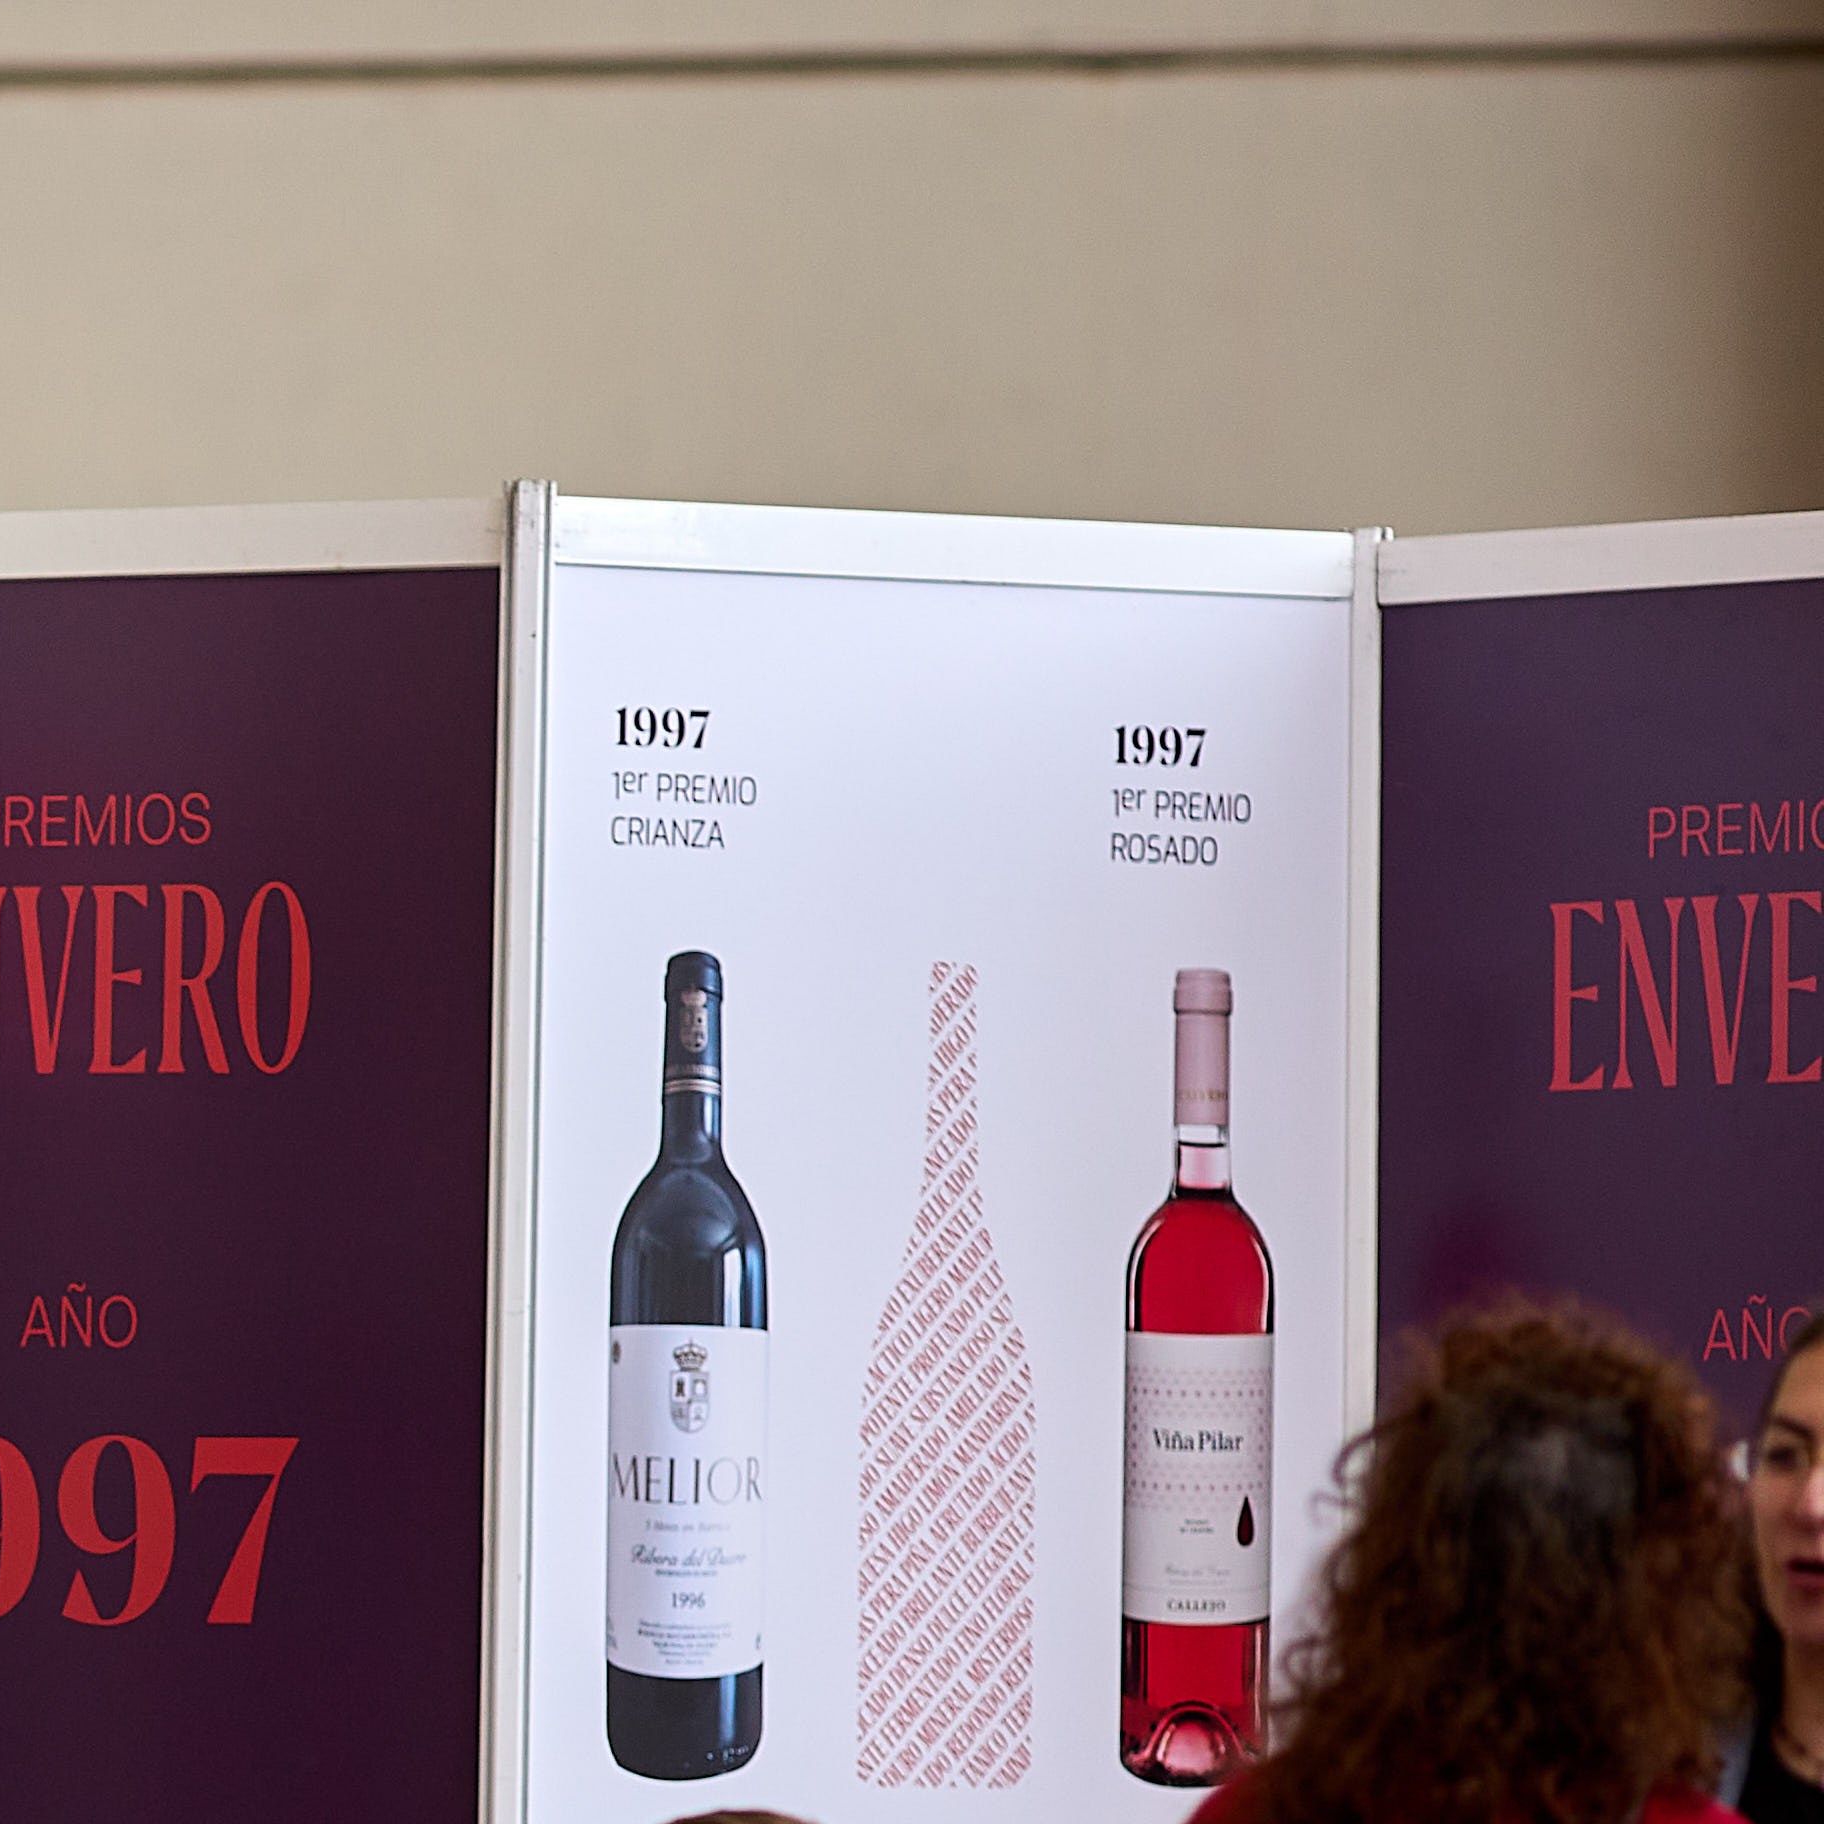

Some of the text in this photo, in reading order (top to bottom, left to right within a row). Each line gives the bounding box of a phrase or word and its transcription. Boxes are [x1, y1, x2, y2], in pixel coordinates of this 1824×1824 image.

[616, 706, 711, 749] 1997
[1115, 725, 1208, 768] 1997
[656, 772, 758, 806] PREMIO
[1154, 790, 1253, 824] PREMIO
[610, 815, 726, 850] CRIANZA
[1111, 832, 1219, 868] ROSADO
[20, 1282, 139, 1350] AÑO
[1153, 1427, 1244, 1452] Viña Pilar
[611, 1452, 763, 1505] MELIOR
